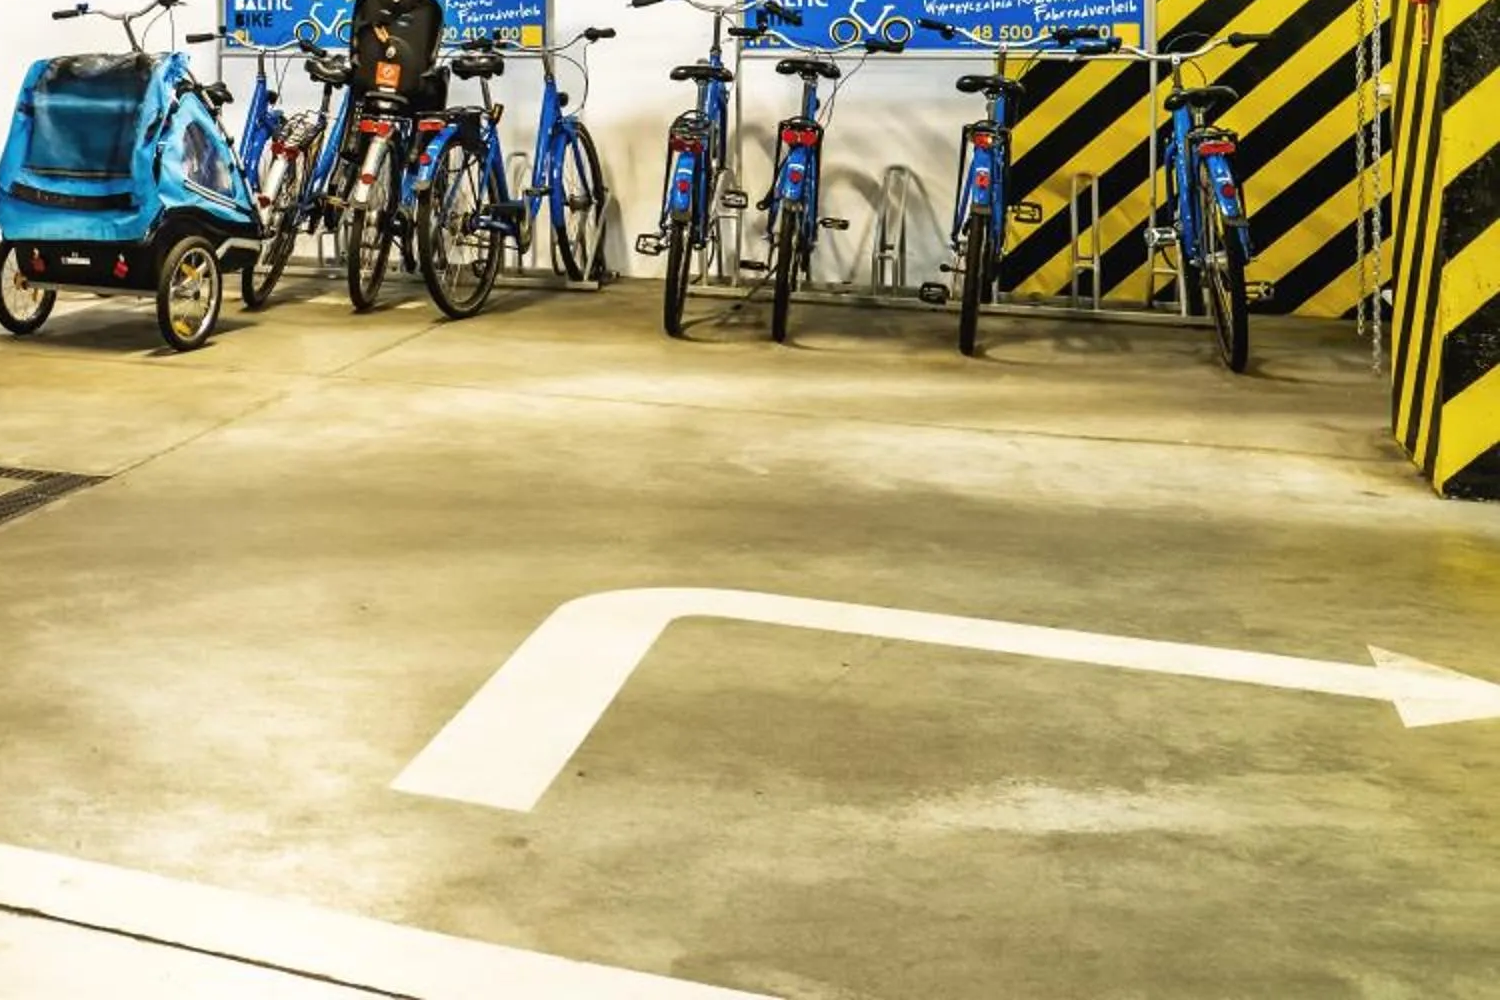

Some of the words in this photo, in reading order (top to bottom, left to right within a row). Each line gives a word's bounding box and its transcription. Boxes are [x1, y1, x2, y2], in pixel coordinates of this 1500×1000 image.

[235, 12, 273, 27] BIKE
[492, 26, 519, 39] 00
[1000, 25, 1033, 39] 500
